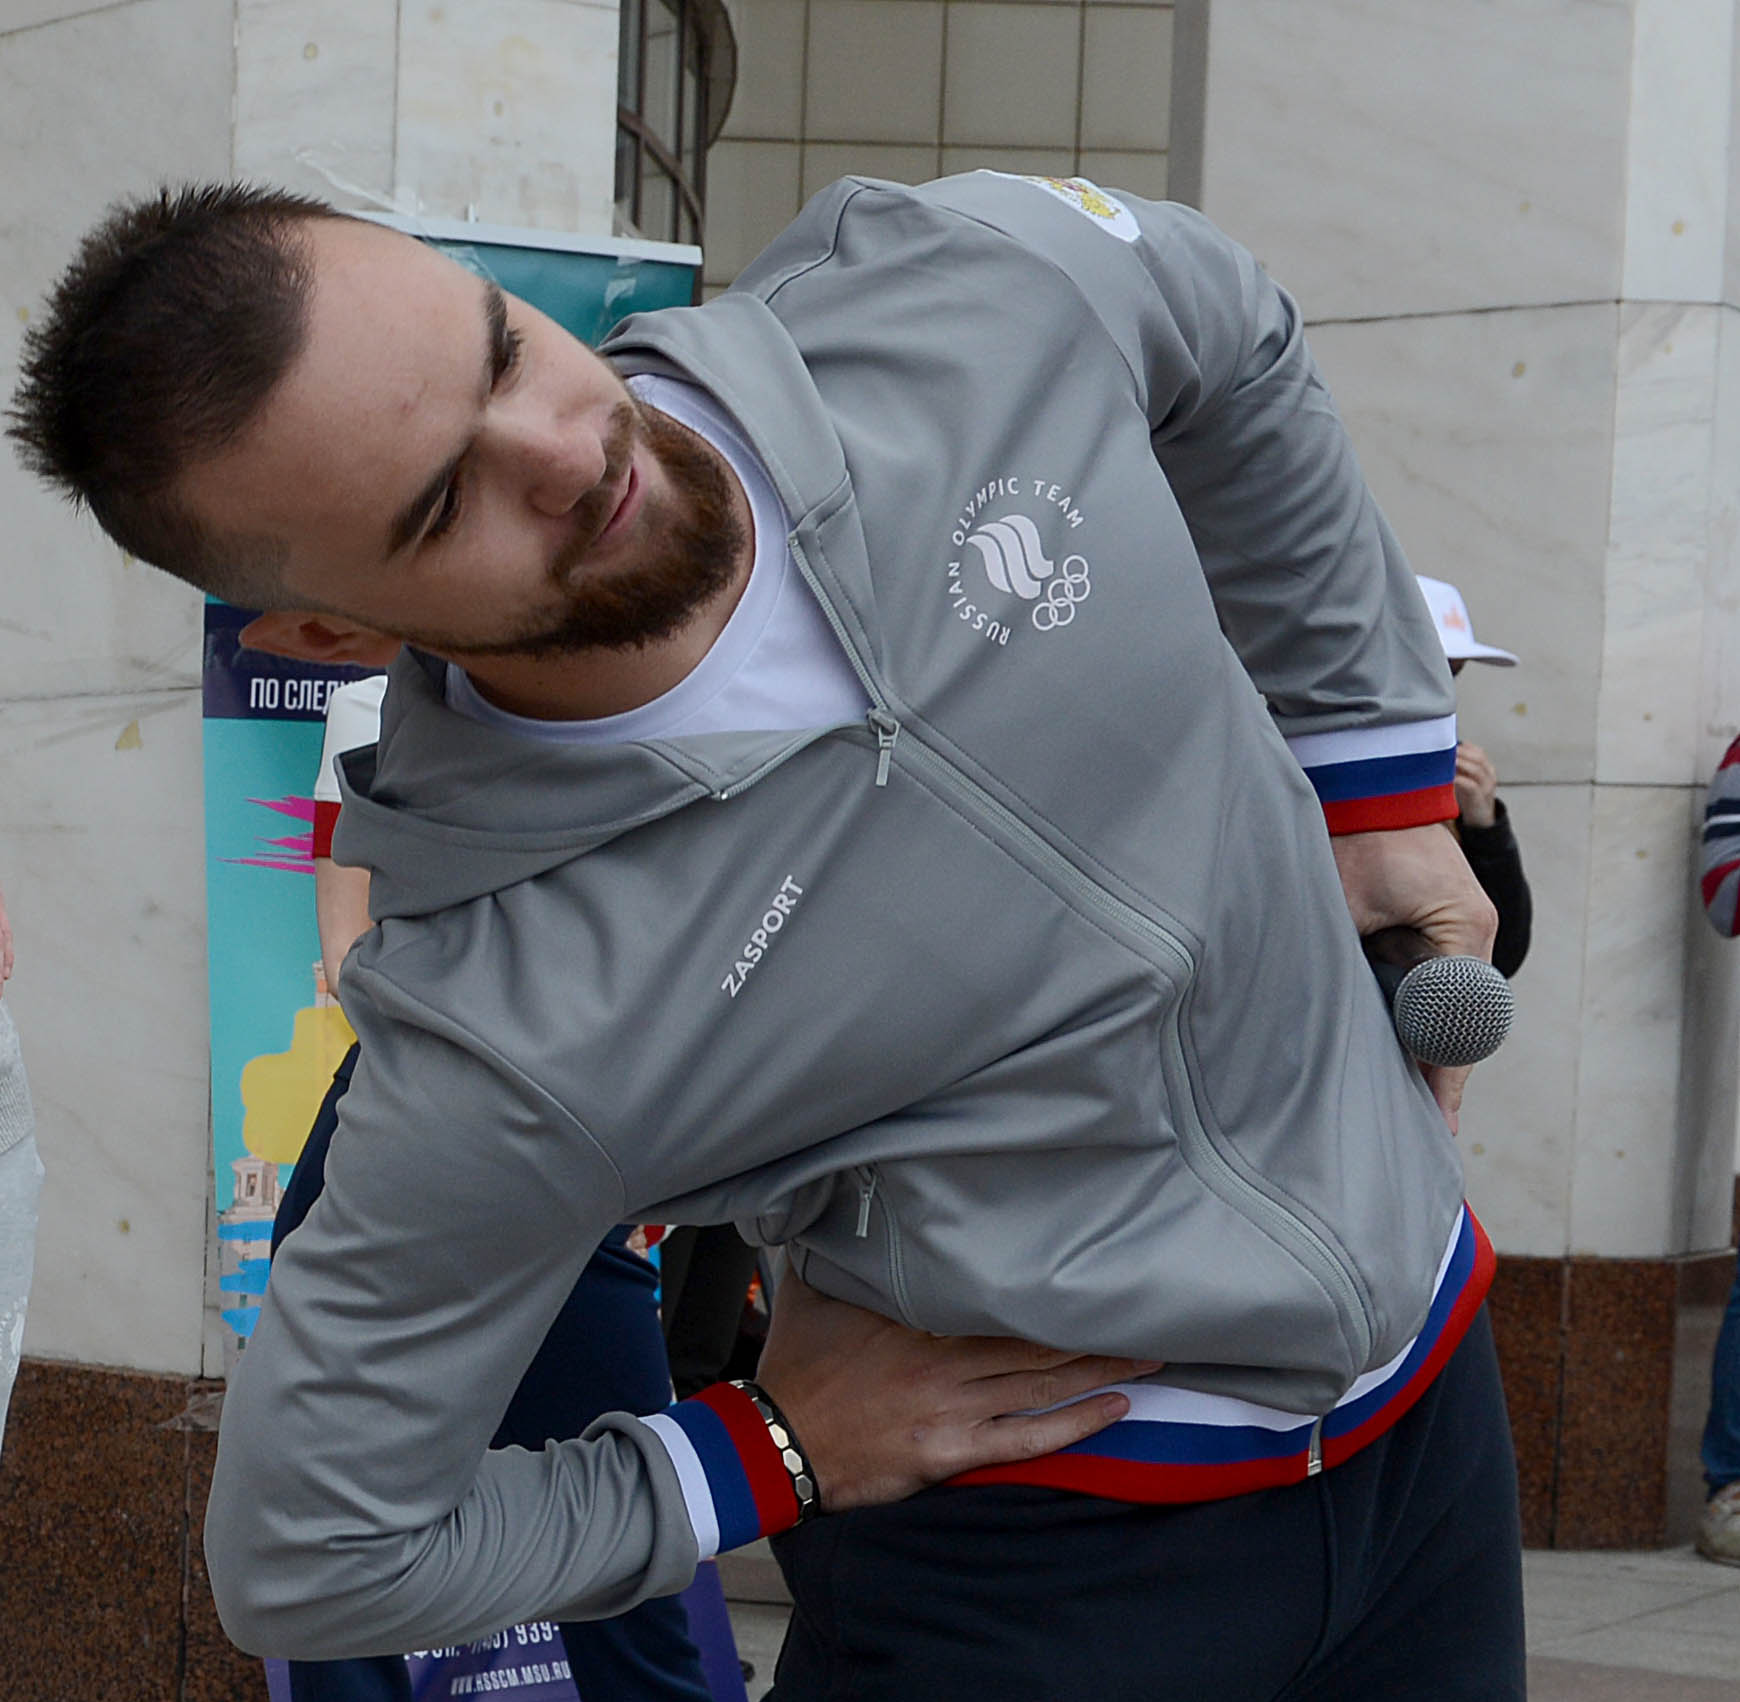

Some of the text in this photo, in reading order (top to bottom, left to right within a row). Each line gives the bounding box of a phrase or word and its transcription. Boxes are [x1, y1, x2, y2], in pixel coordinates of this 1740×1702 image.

[948, 476, 1084, 646] RUSSIAN OLYMPIC TEAM
[250, 677, 280, 709] ПО
[721, 874, 804, 998] ZASPORT
